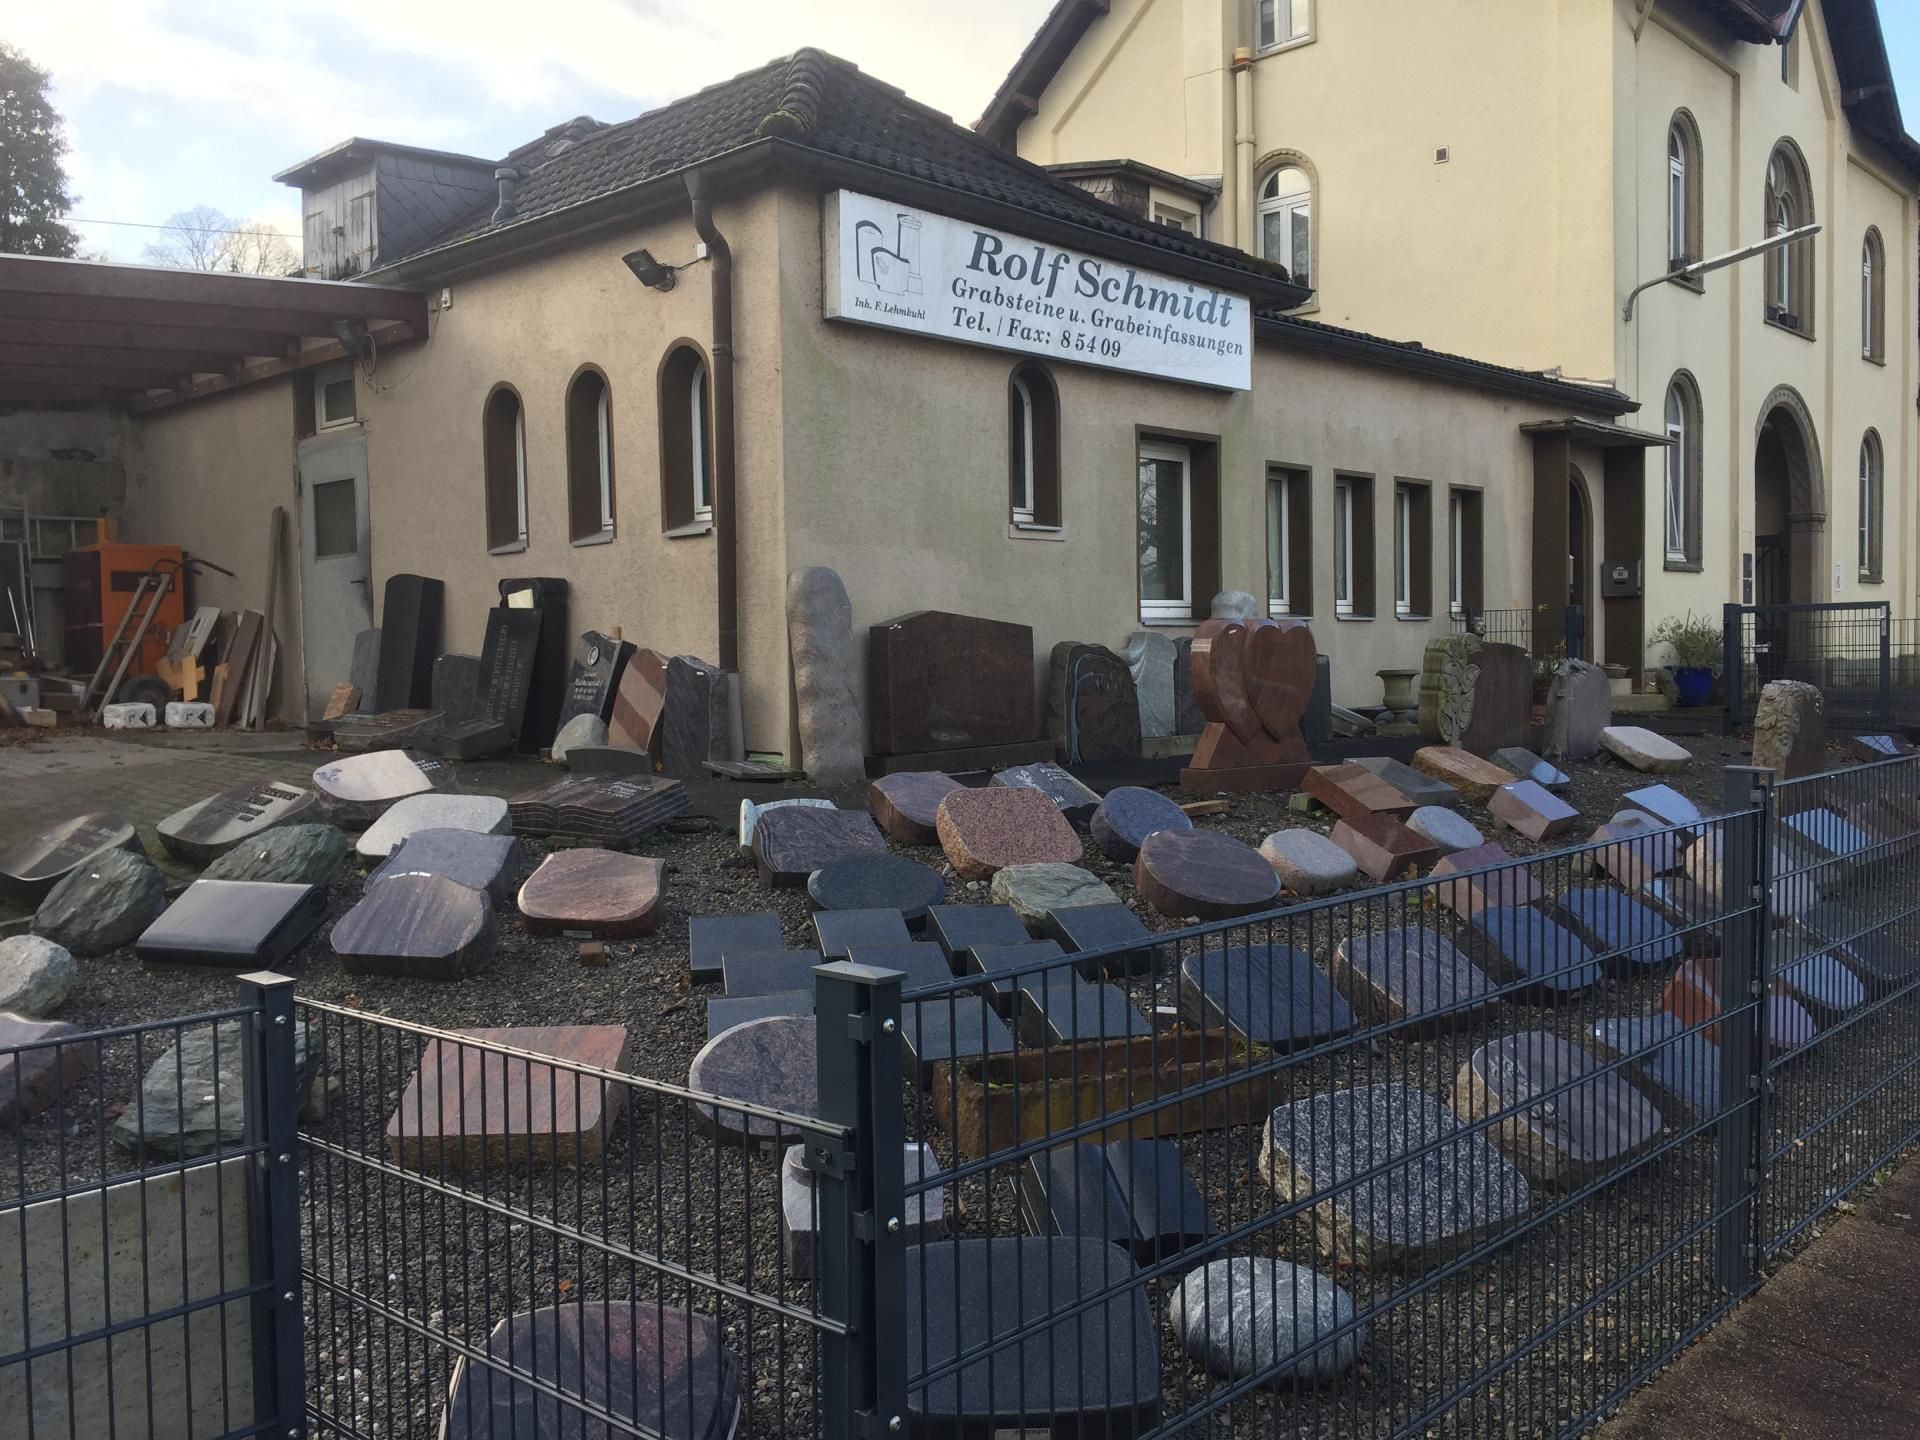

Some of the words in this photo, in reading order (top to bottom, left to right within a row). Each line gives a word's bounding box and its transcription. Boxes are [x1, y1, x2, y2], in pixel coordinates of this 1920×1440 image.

[855, 296, 872, 310] Inh.
[884, 302, 926, 320] Lehmkuhl
[966, 230, 1071, 298] Rolf
[1074, 259, 1233, 328] Schmidt
[952, 277, 1065, 320] Grabsteine
[1069, 308, 1086, 324] u.
[1091, 308, 1243, 357] Grabeinfassungen
[953, 306, 991, 333] Tel.
[1007, 318, 1051, 345] Fax:
